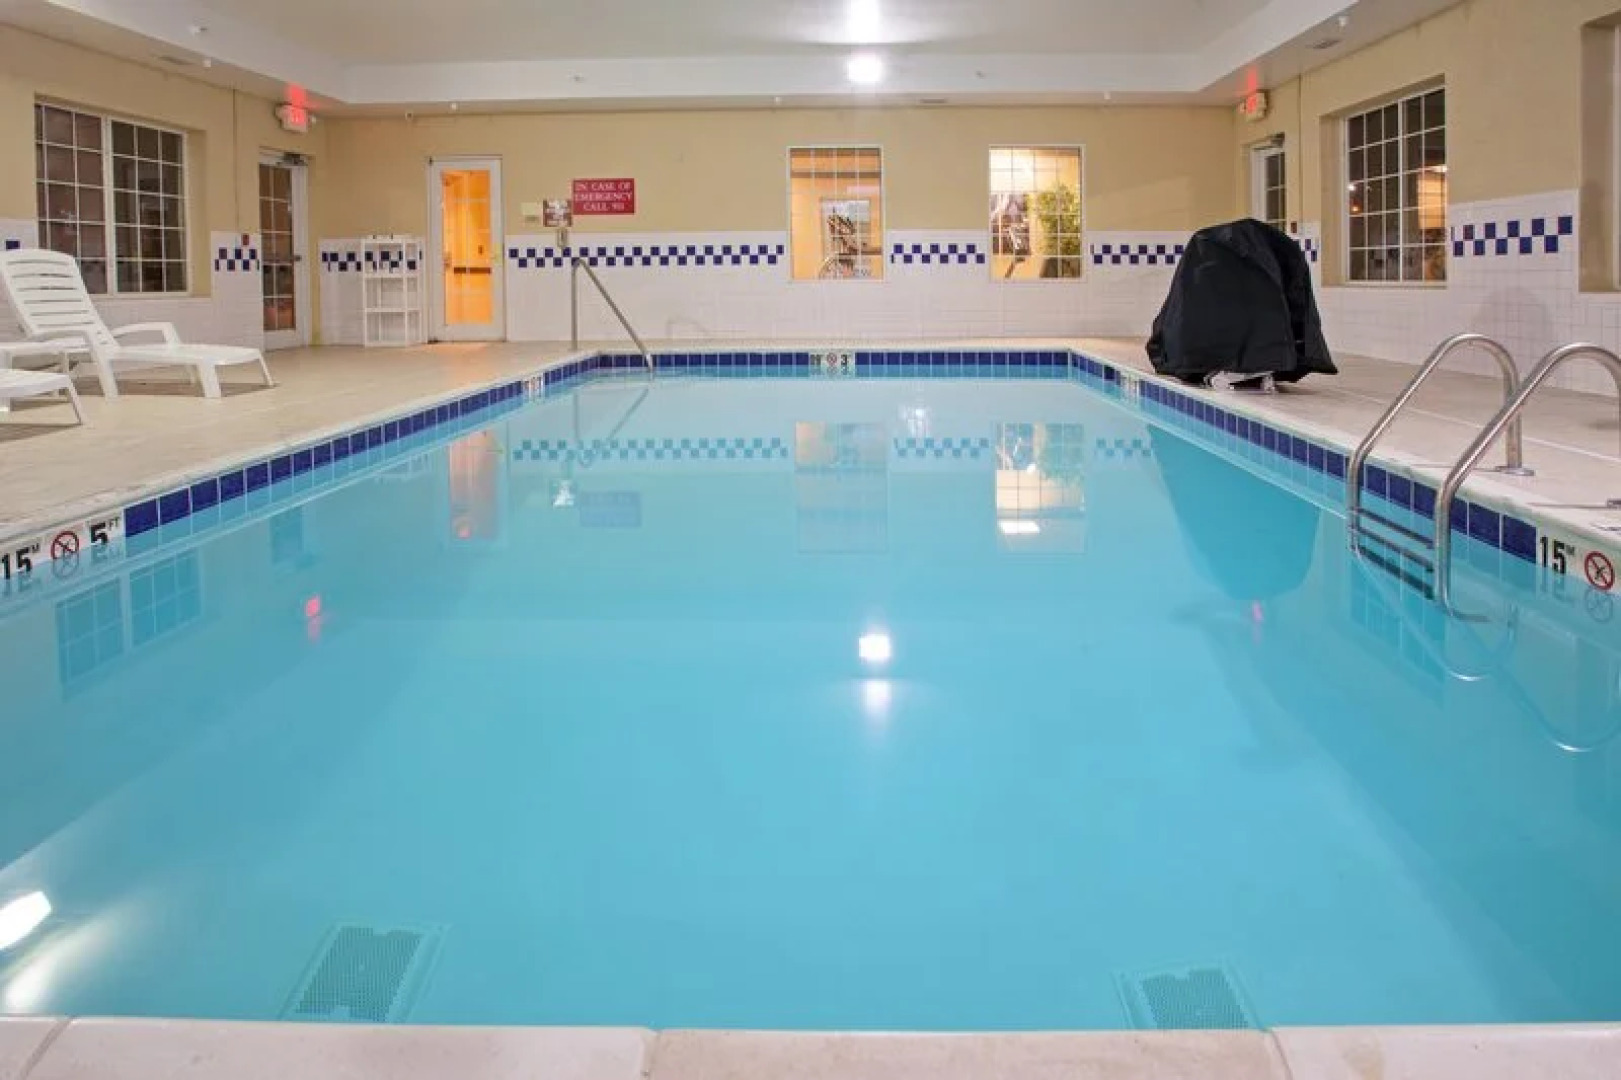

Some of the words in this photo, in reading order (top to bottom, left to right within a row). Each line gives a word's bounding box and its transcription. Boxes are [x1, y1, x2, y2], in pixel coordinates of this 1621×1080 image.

[576, 182, 588, 191] IN
[591, 182, 616, 191] CASE
[618, 182, 631, 191] OF
[575, 192, 632, 201] EMERGENCY
[583, 202, 609, 211] CALL
